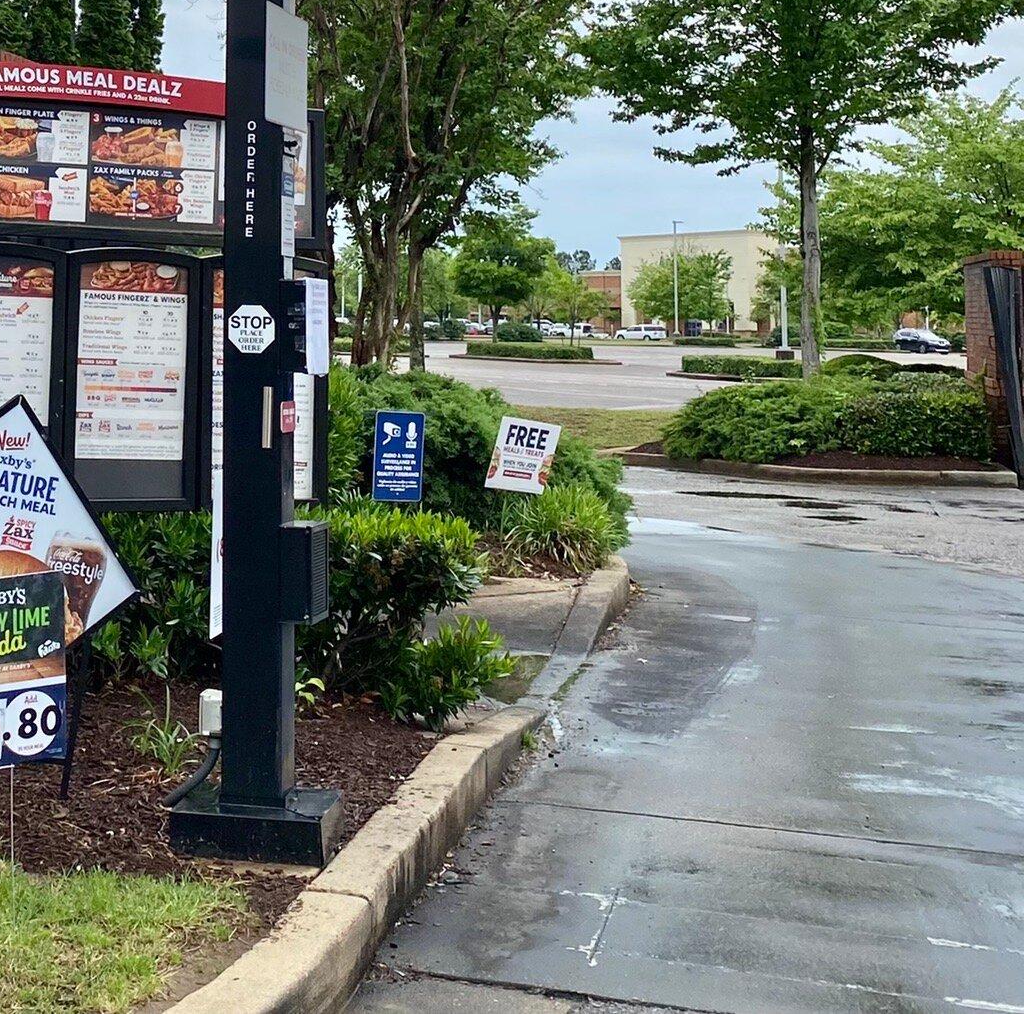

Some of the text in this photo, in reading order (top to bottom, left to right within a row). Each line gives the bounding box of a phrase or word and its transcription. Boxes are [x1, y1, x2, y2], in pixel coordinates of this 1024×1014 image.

[66, 71, 118, 90] MEAL
[123, 75, 183, 97] DEALZ
[65, 87, 92, 96] CRINKLE
[93, 89, 111, 97] FRIES
[5, 107, 32, 116] FINGER
[33, 110, 55, 118] PLATE
[93, 114, 162, 126] 3 WINGS & THINGS
[93, 166, 109, 174] ZAX
[109, 167, 135, 175] FAMILY
[137, 169, 159, 177] PACKS
[245, 120, 257, 238] ORDER HERE
[84, 292, 186, 304] FAMOUS FINGERZ & WINGS
[231, 315, 273, 329] STOP
[505, 424, 550, 451] FREE
[525, 449, 544, 458] TREATS
[20, 499, 57, 516] MEAL
[16, 518, 36, 529] SPICY
[3, 522, 35, 540] Zax
[12, 606, 51, 636] LIME
[2, 705, 62, 741] .80
